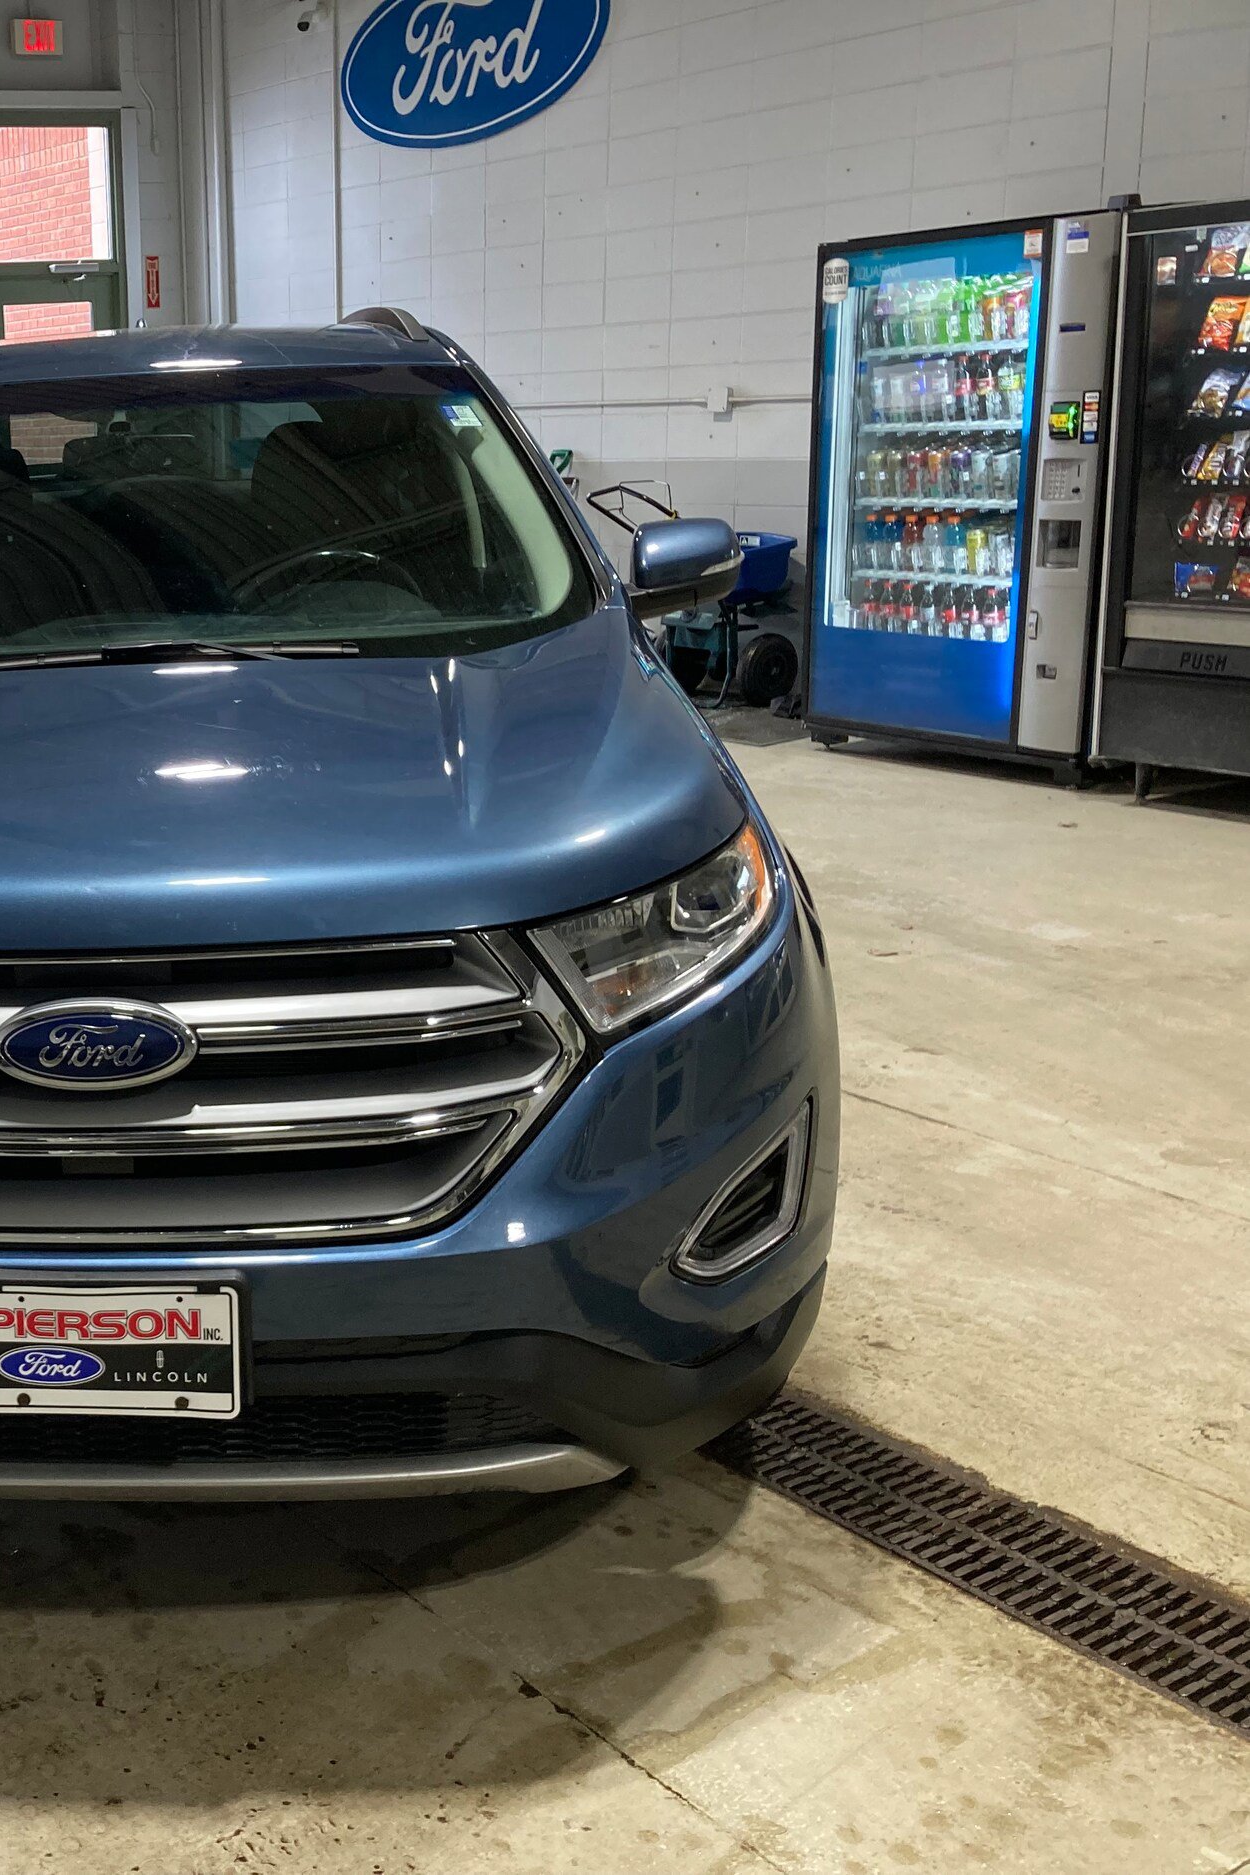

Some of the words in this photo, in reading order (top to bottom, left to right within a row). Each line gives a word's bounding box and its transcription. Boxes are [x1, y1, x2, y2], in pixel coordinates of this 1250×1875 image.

[392, 0, 540, 115] Ford
[824, 274, 847, 286] COUNT
[1180, 652, 1228, 671] PUSH
[39, 1023, 146, 1068] Ford
[203, 1327, 224, 1341] INC.
[18, 1351, 81, 1378] Ford
[113, 1371, 208, 1384] LINCOLN
